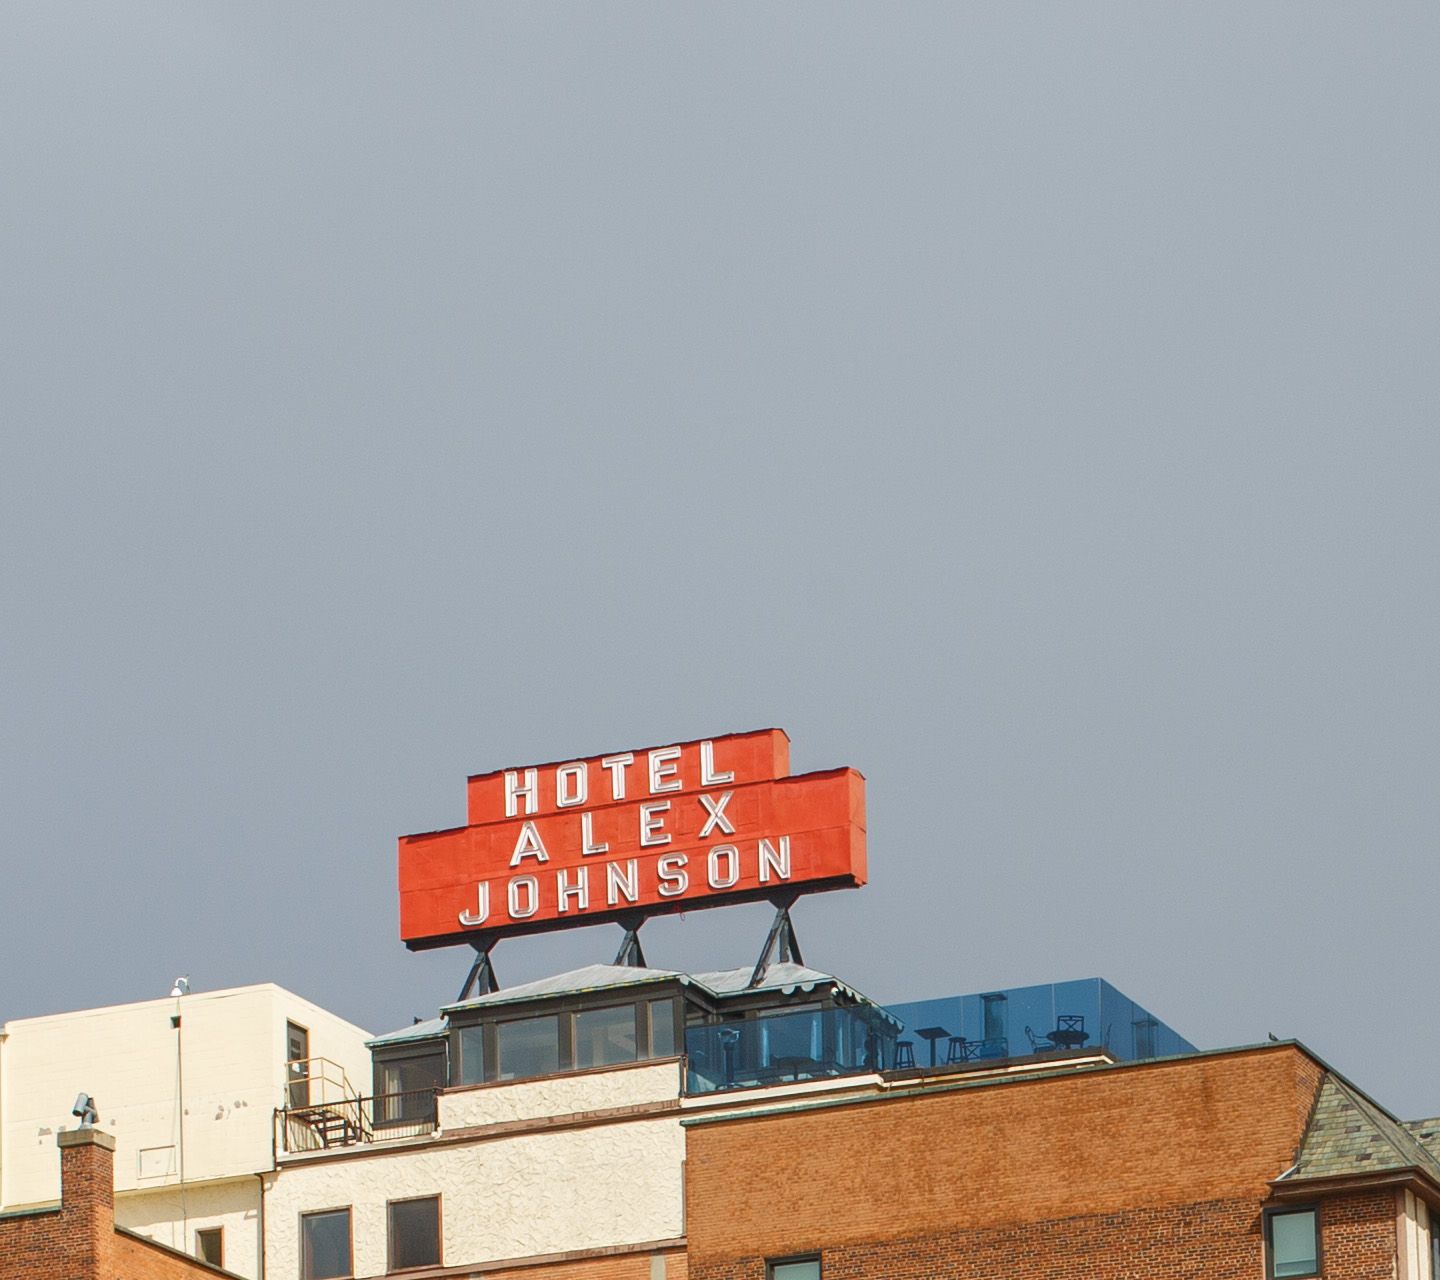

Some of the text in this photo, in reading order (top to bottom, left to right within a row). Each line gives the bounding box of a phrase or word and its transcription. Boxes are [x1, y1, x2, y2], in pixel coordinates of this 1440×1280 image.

[504, 740, 734, 817] HOTEL
[510, 790, 736, 867] ALEX
[459, 836, 791, 926] JOHNSON
